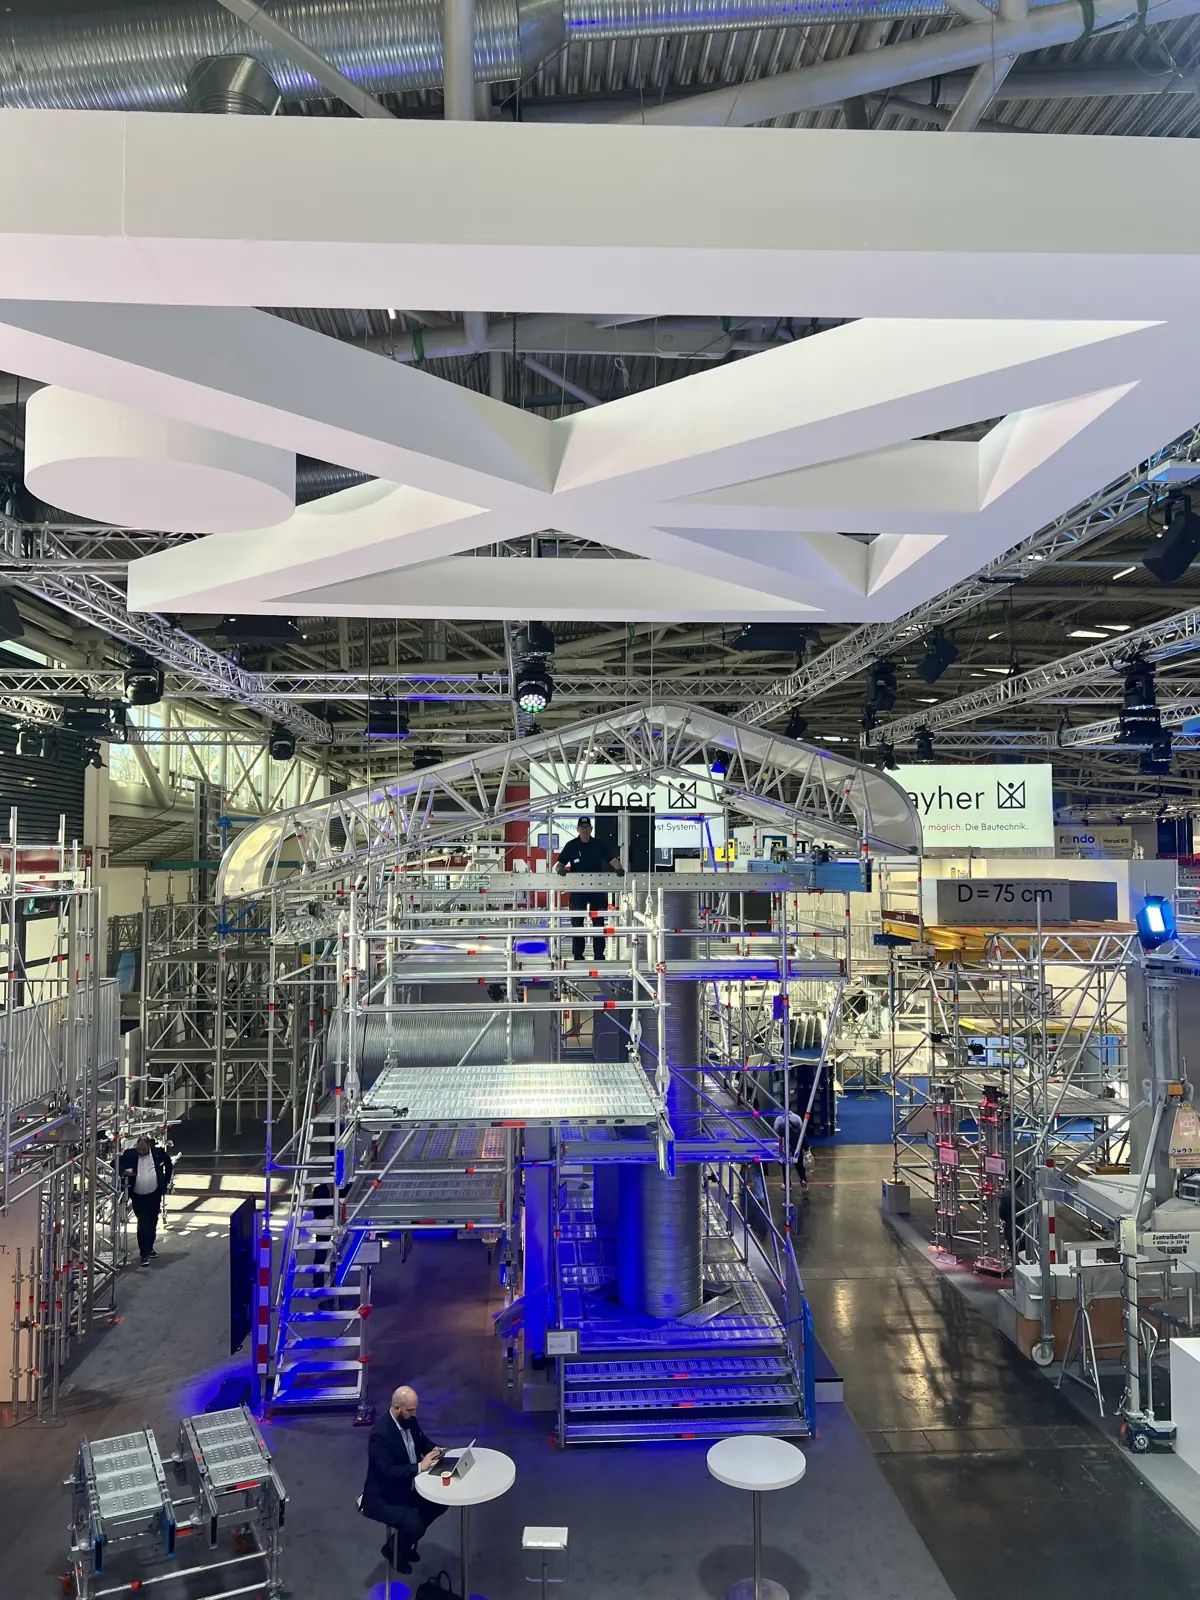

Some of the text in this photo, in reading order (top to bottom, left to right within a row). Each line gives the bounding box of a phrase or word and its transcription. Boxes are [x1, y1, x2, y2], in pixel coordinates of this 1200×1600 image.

[906, 785, 985, 815] ayher
[666, 822, 699, 832] System.
[928, 823, 963, 833] möglich.
[965, 823, 979, 831] Die
[981, 822, 1028, 831] Bautechnik.
[1021, 889, 1052, 902] cm
